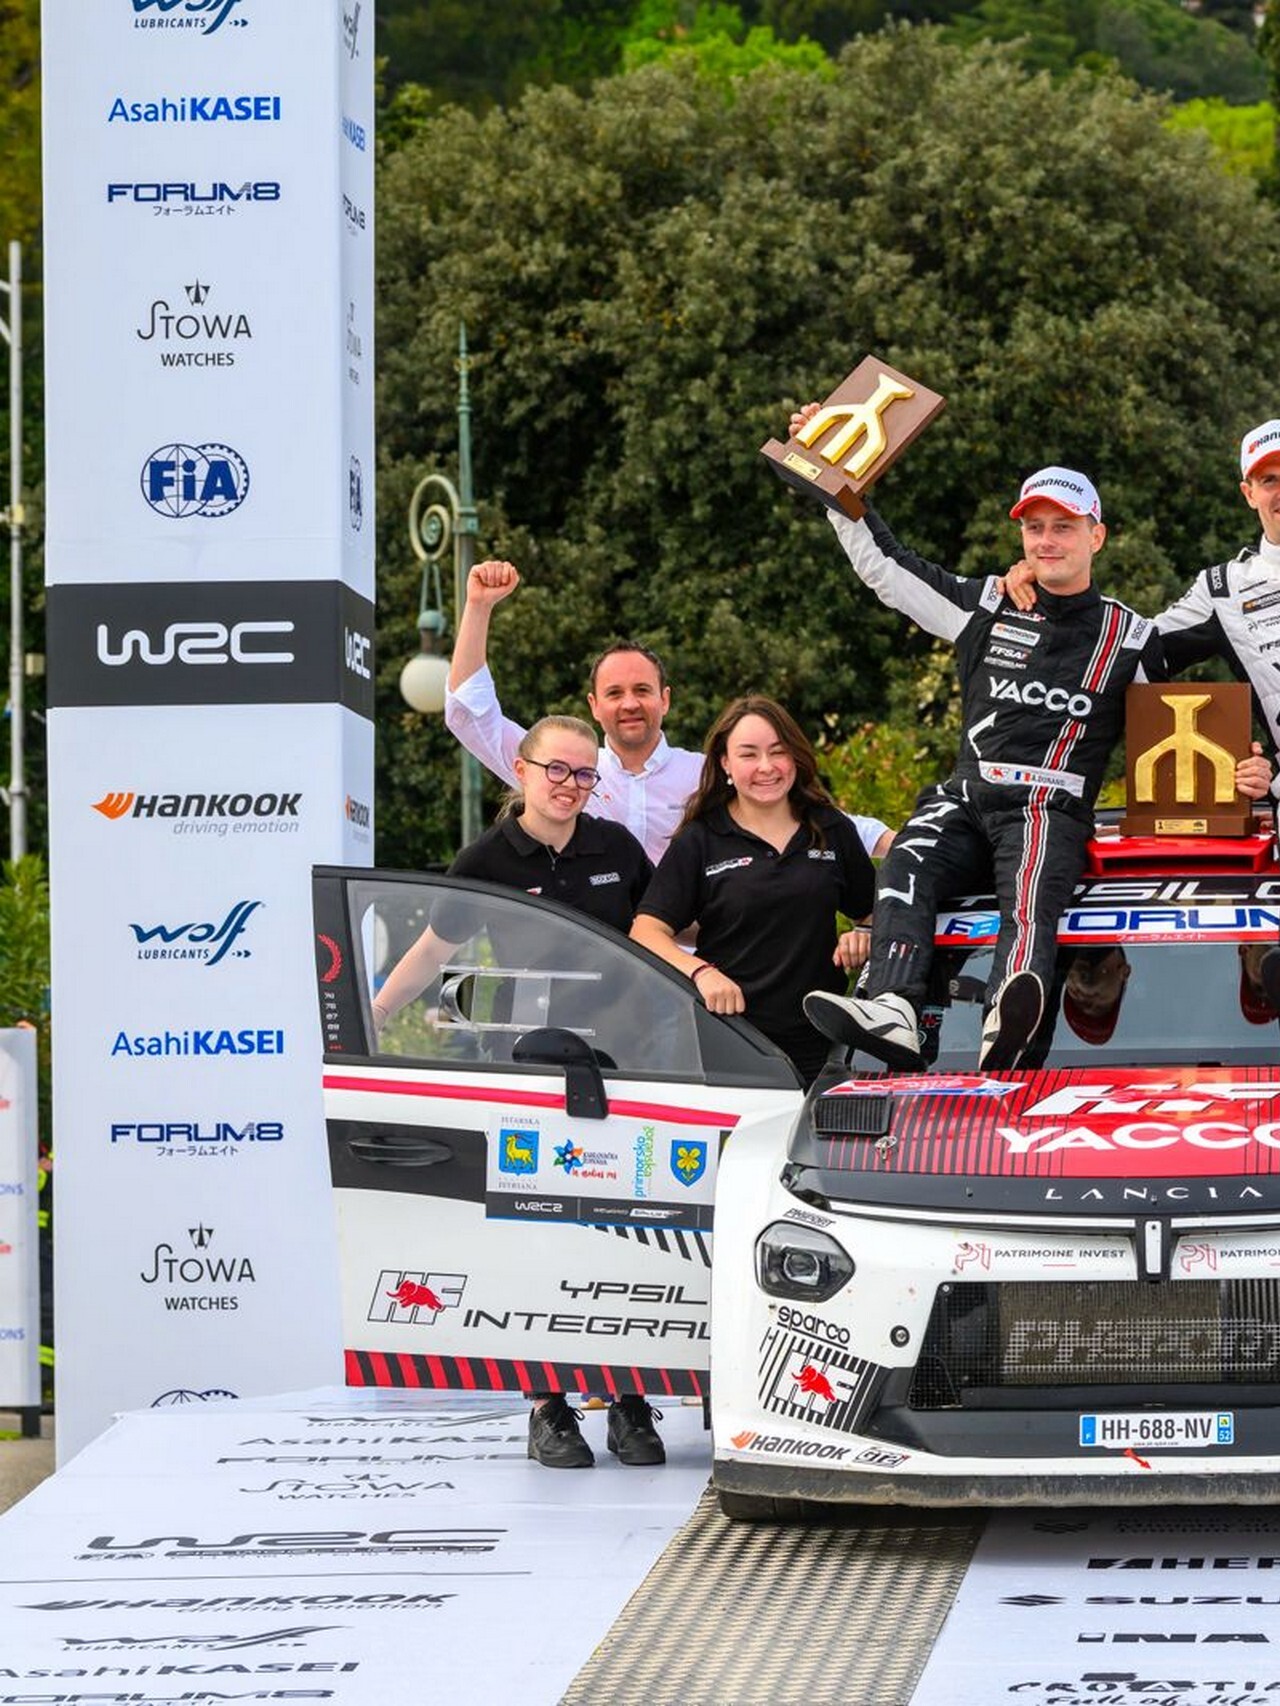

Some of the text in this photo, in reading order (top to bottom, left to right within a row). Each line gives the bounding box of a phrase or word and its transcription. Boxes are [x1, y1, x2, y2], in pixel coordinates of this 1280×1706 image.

[134, 18, 206, 28] LUBRICANTS
[107, 182, 281, 203] FORUM8
[160, 353, 235, 367] WATCHES
[97, 622, 294, 665] WRC
[988, 676, 1092, 717] YACCO
[173, 820, 299, 837] driving emotion
[138, 949, 209, 959] LUBRICANTS
[111, 1122, 284, 1143] FORUM8
[1045, 1186, 1263, 1200] LANCIA
[515, 1201, 563, 1212] WRC2
[995, 1249, 1126, 1258] PATRIMOINE INVEST
[164, 1297, 238, 1311] WATCHES
[777, 1304, 850, 1345] sparco
[1102, 1418, 1212, 1440] HH-688-NV
[1219, 1428, 1232, 1441] 52
[87, 1529, 508, 1550] WRC
